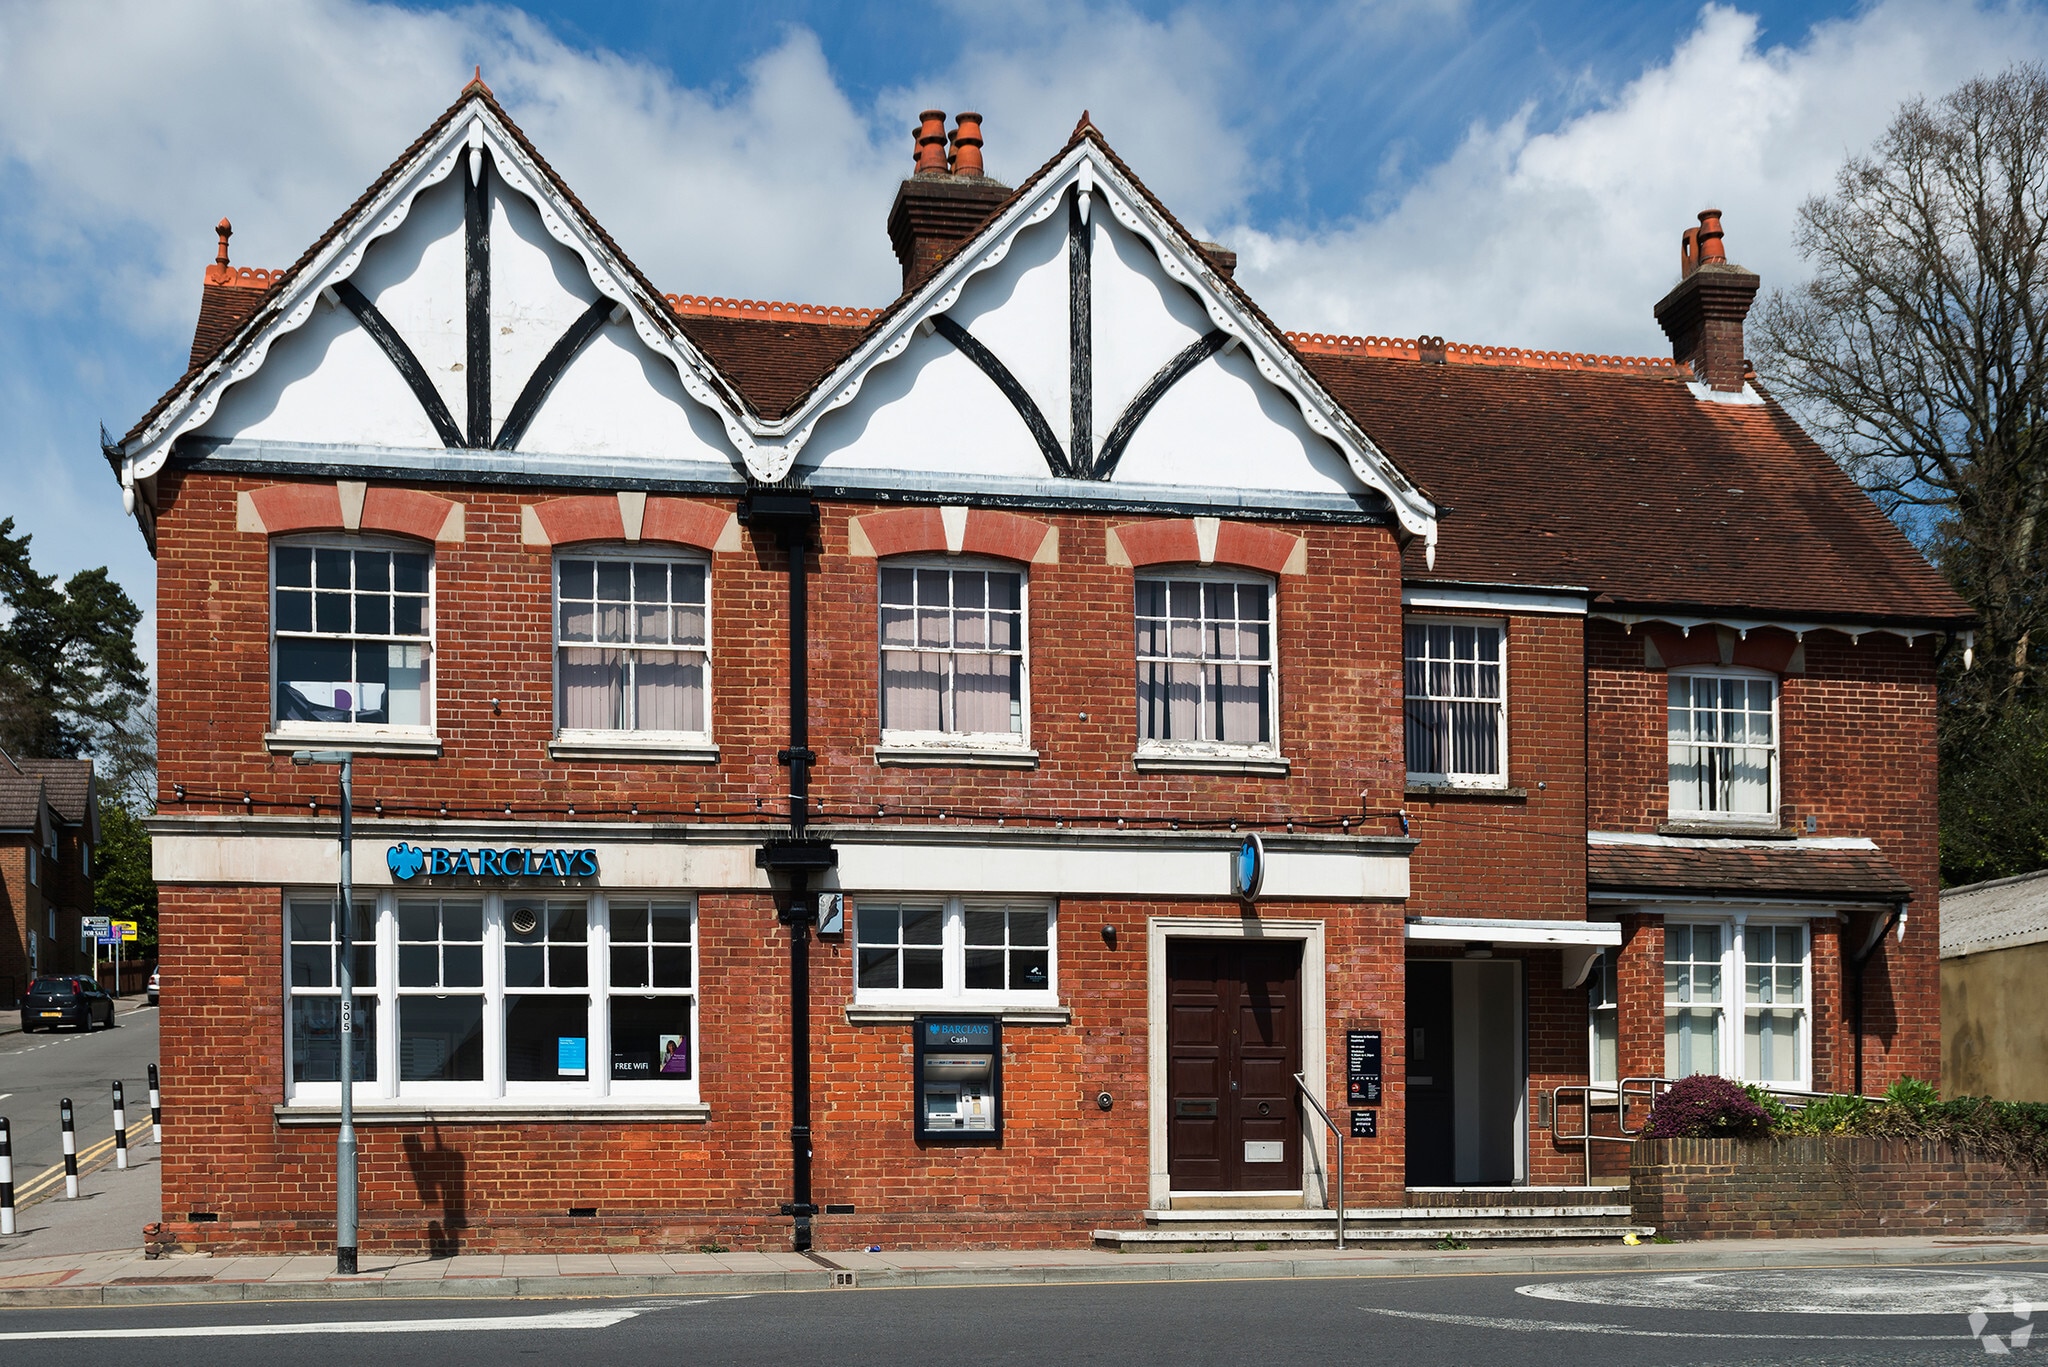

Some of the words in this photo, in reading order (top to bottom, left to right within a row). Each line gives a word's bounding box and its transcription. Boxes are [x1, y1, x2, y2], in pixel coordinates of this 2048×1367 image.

[430, 848, 598, 877] BARCLAYS
[941, 1024, 989, 1034] BARCLAYS
[950, 1035, 968, 1043] Cash
[615, 1062, 632, 1070] FREE
[633, 1062, 649, 1070] WiFi
